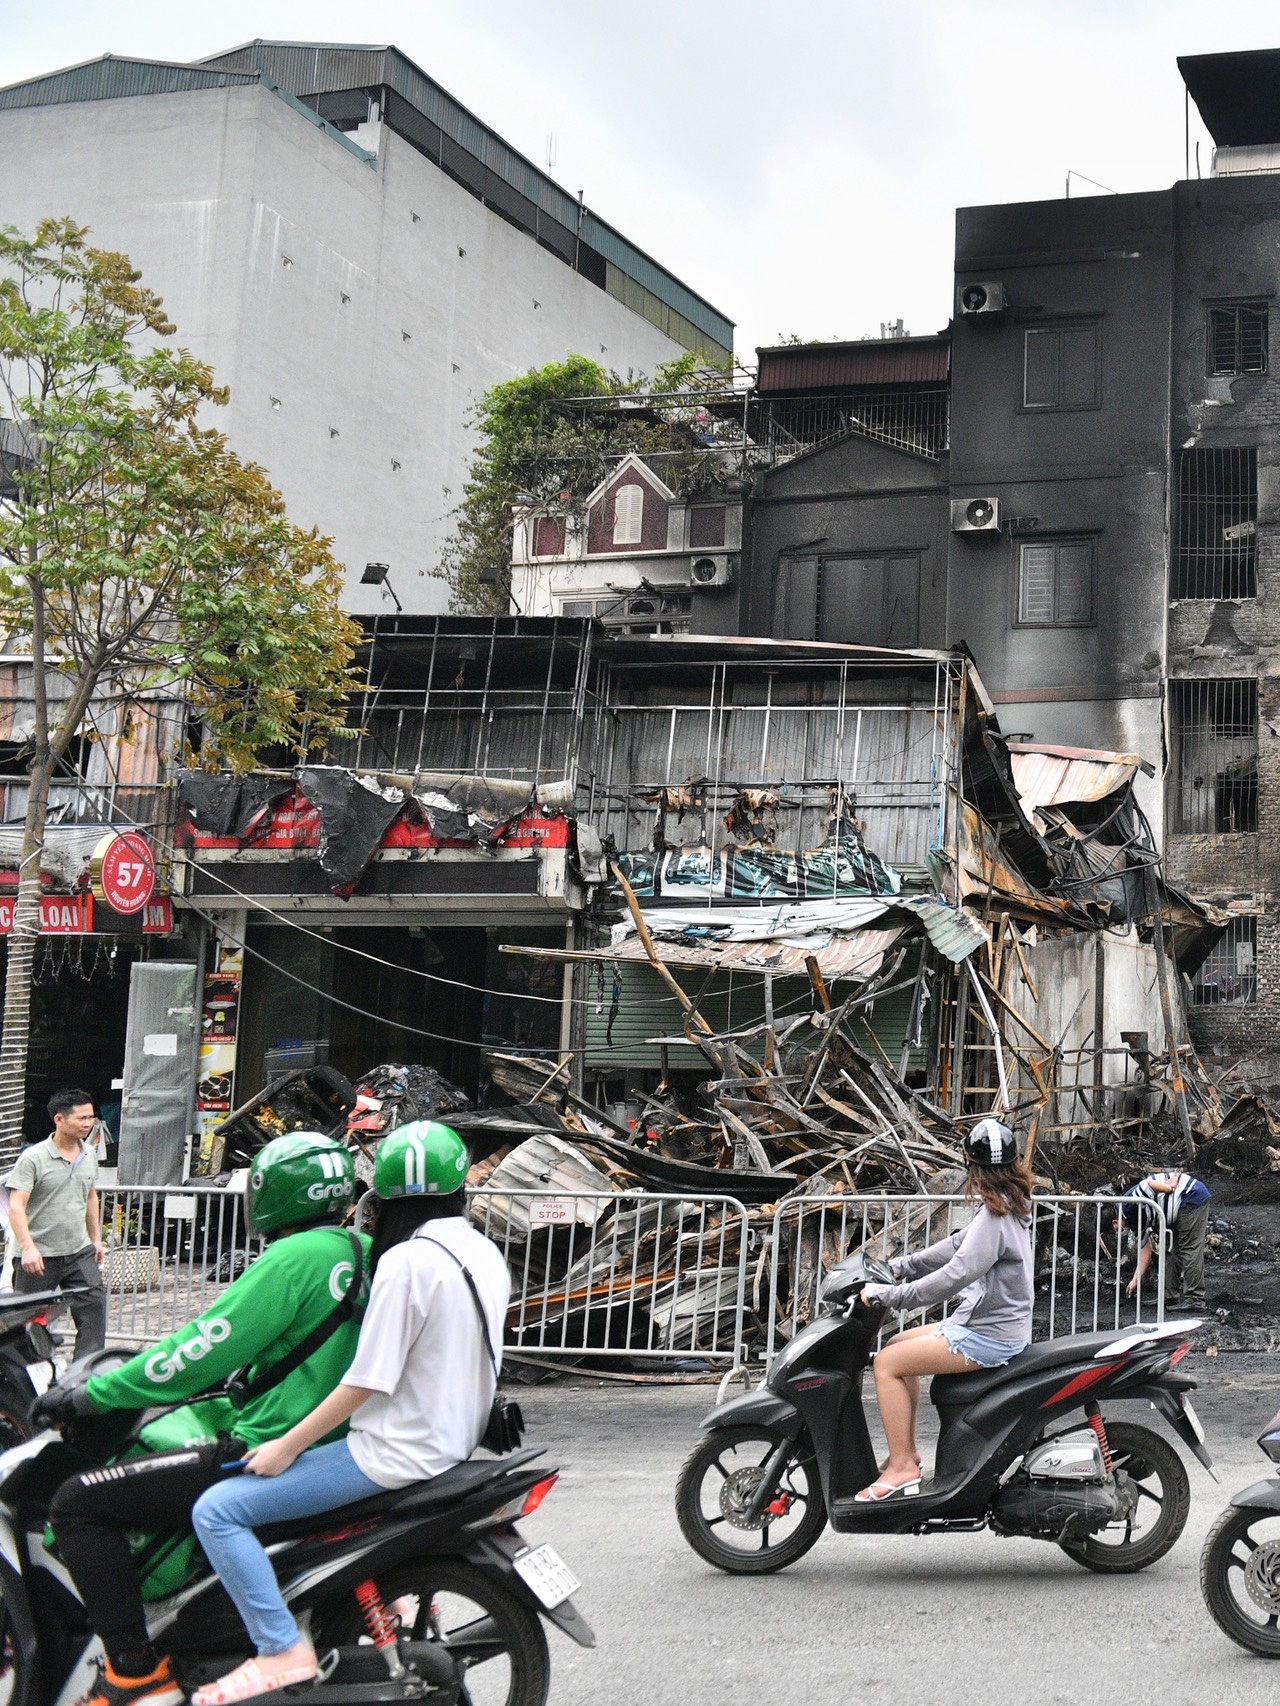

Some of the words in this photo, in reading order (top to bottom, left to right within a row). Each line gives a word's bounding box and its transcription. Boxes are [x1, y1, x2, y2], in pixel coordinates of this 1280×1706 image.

[116, 861, 145, 888] 57
[38, 905, 78, 931] LOẠI
[538, 1211, 566, 1219] STOP
[144, 1317, 233, 1383] Grab
